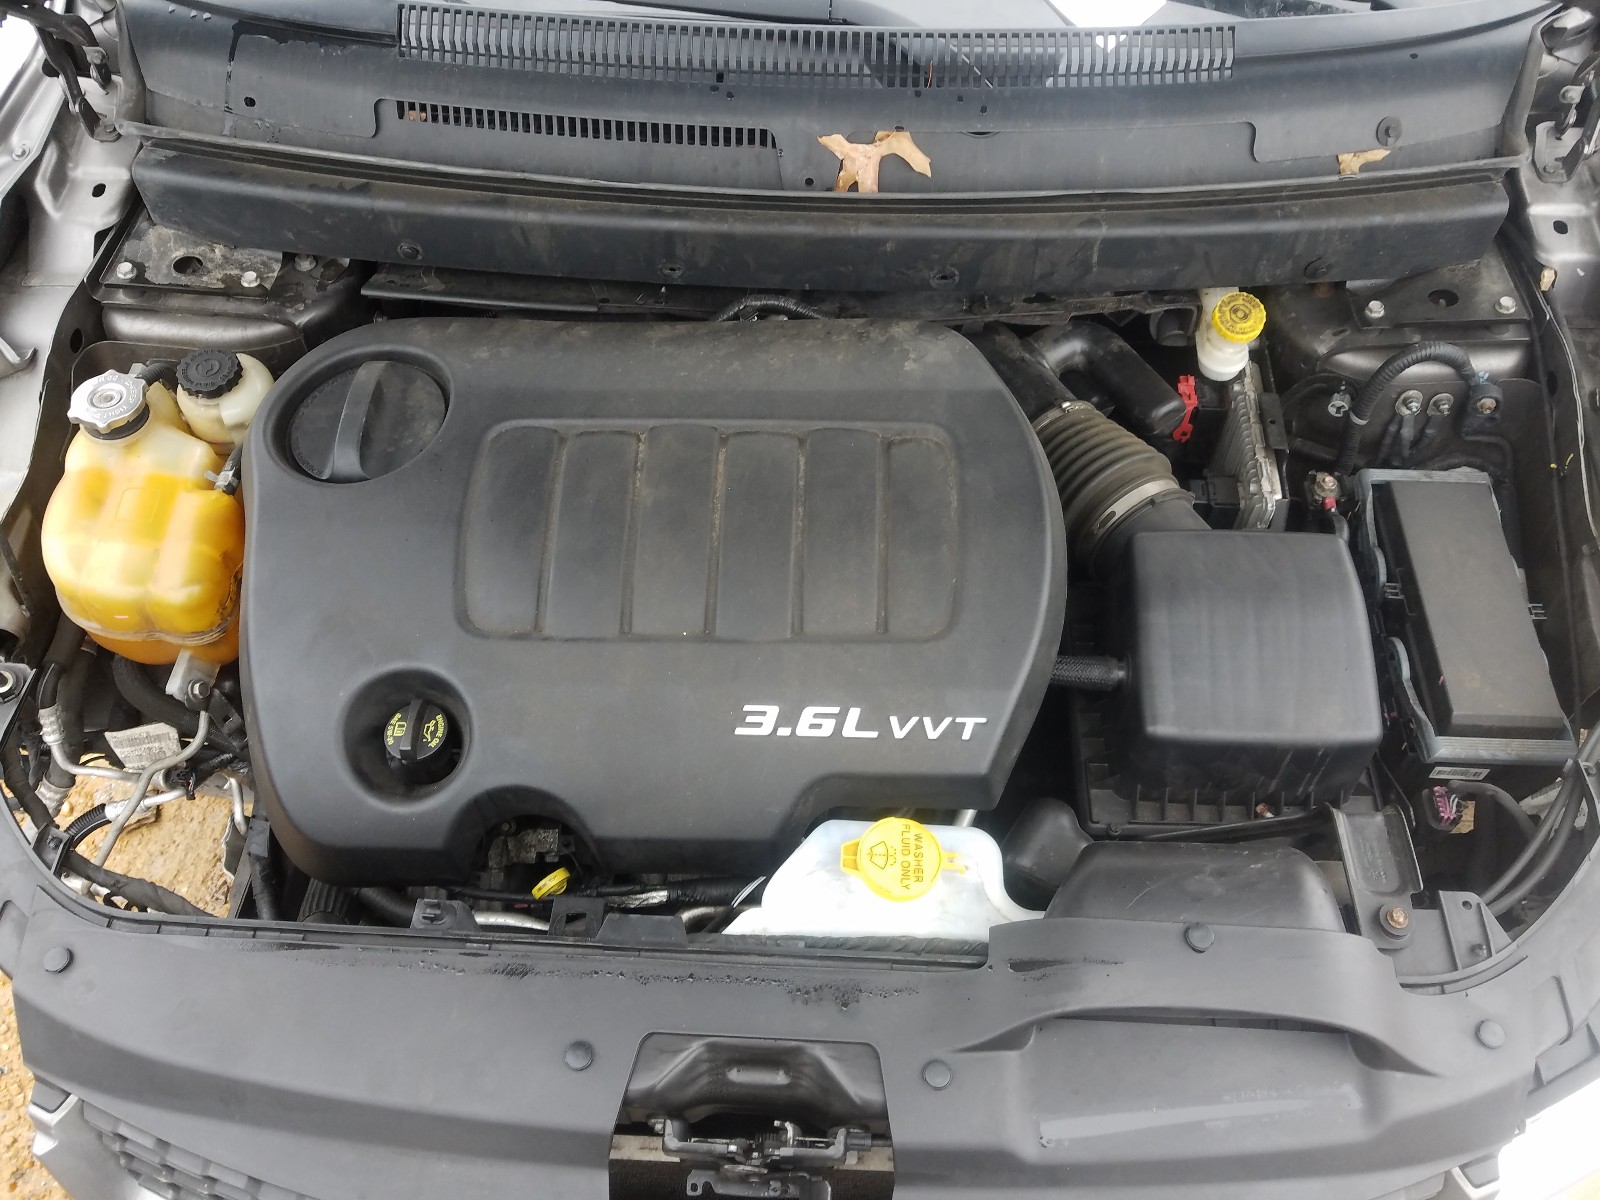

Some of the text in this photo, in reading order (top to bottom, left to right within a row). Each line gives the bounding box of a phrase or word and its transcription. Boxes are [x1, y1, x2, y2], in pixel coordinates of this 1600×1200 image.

[428, 714, 445, 748] ENGINE OIL
[734, 704, 988, 741] 3.6L VVT
[900, 823, 911, 890] FLUID ONLY
[913, 832, 924, 883] WASHER
